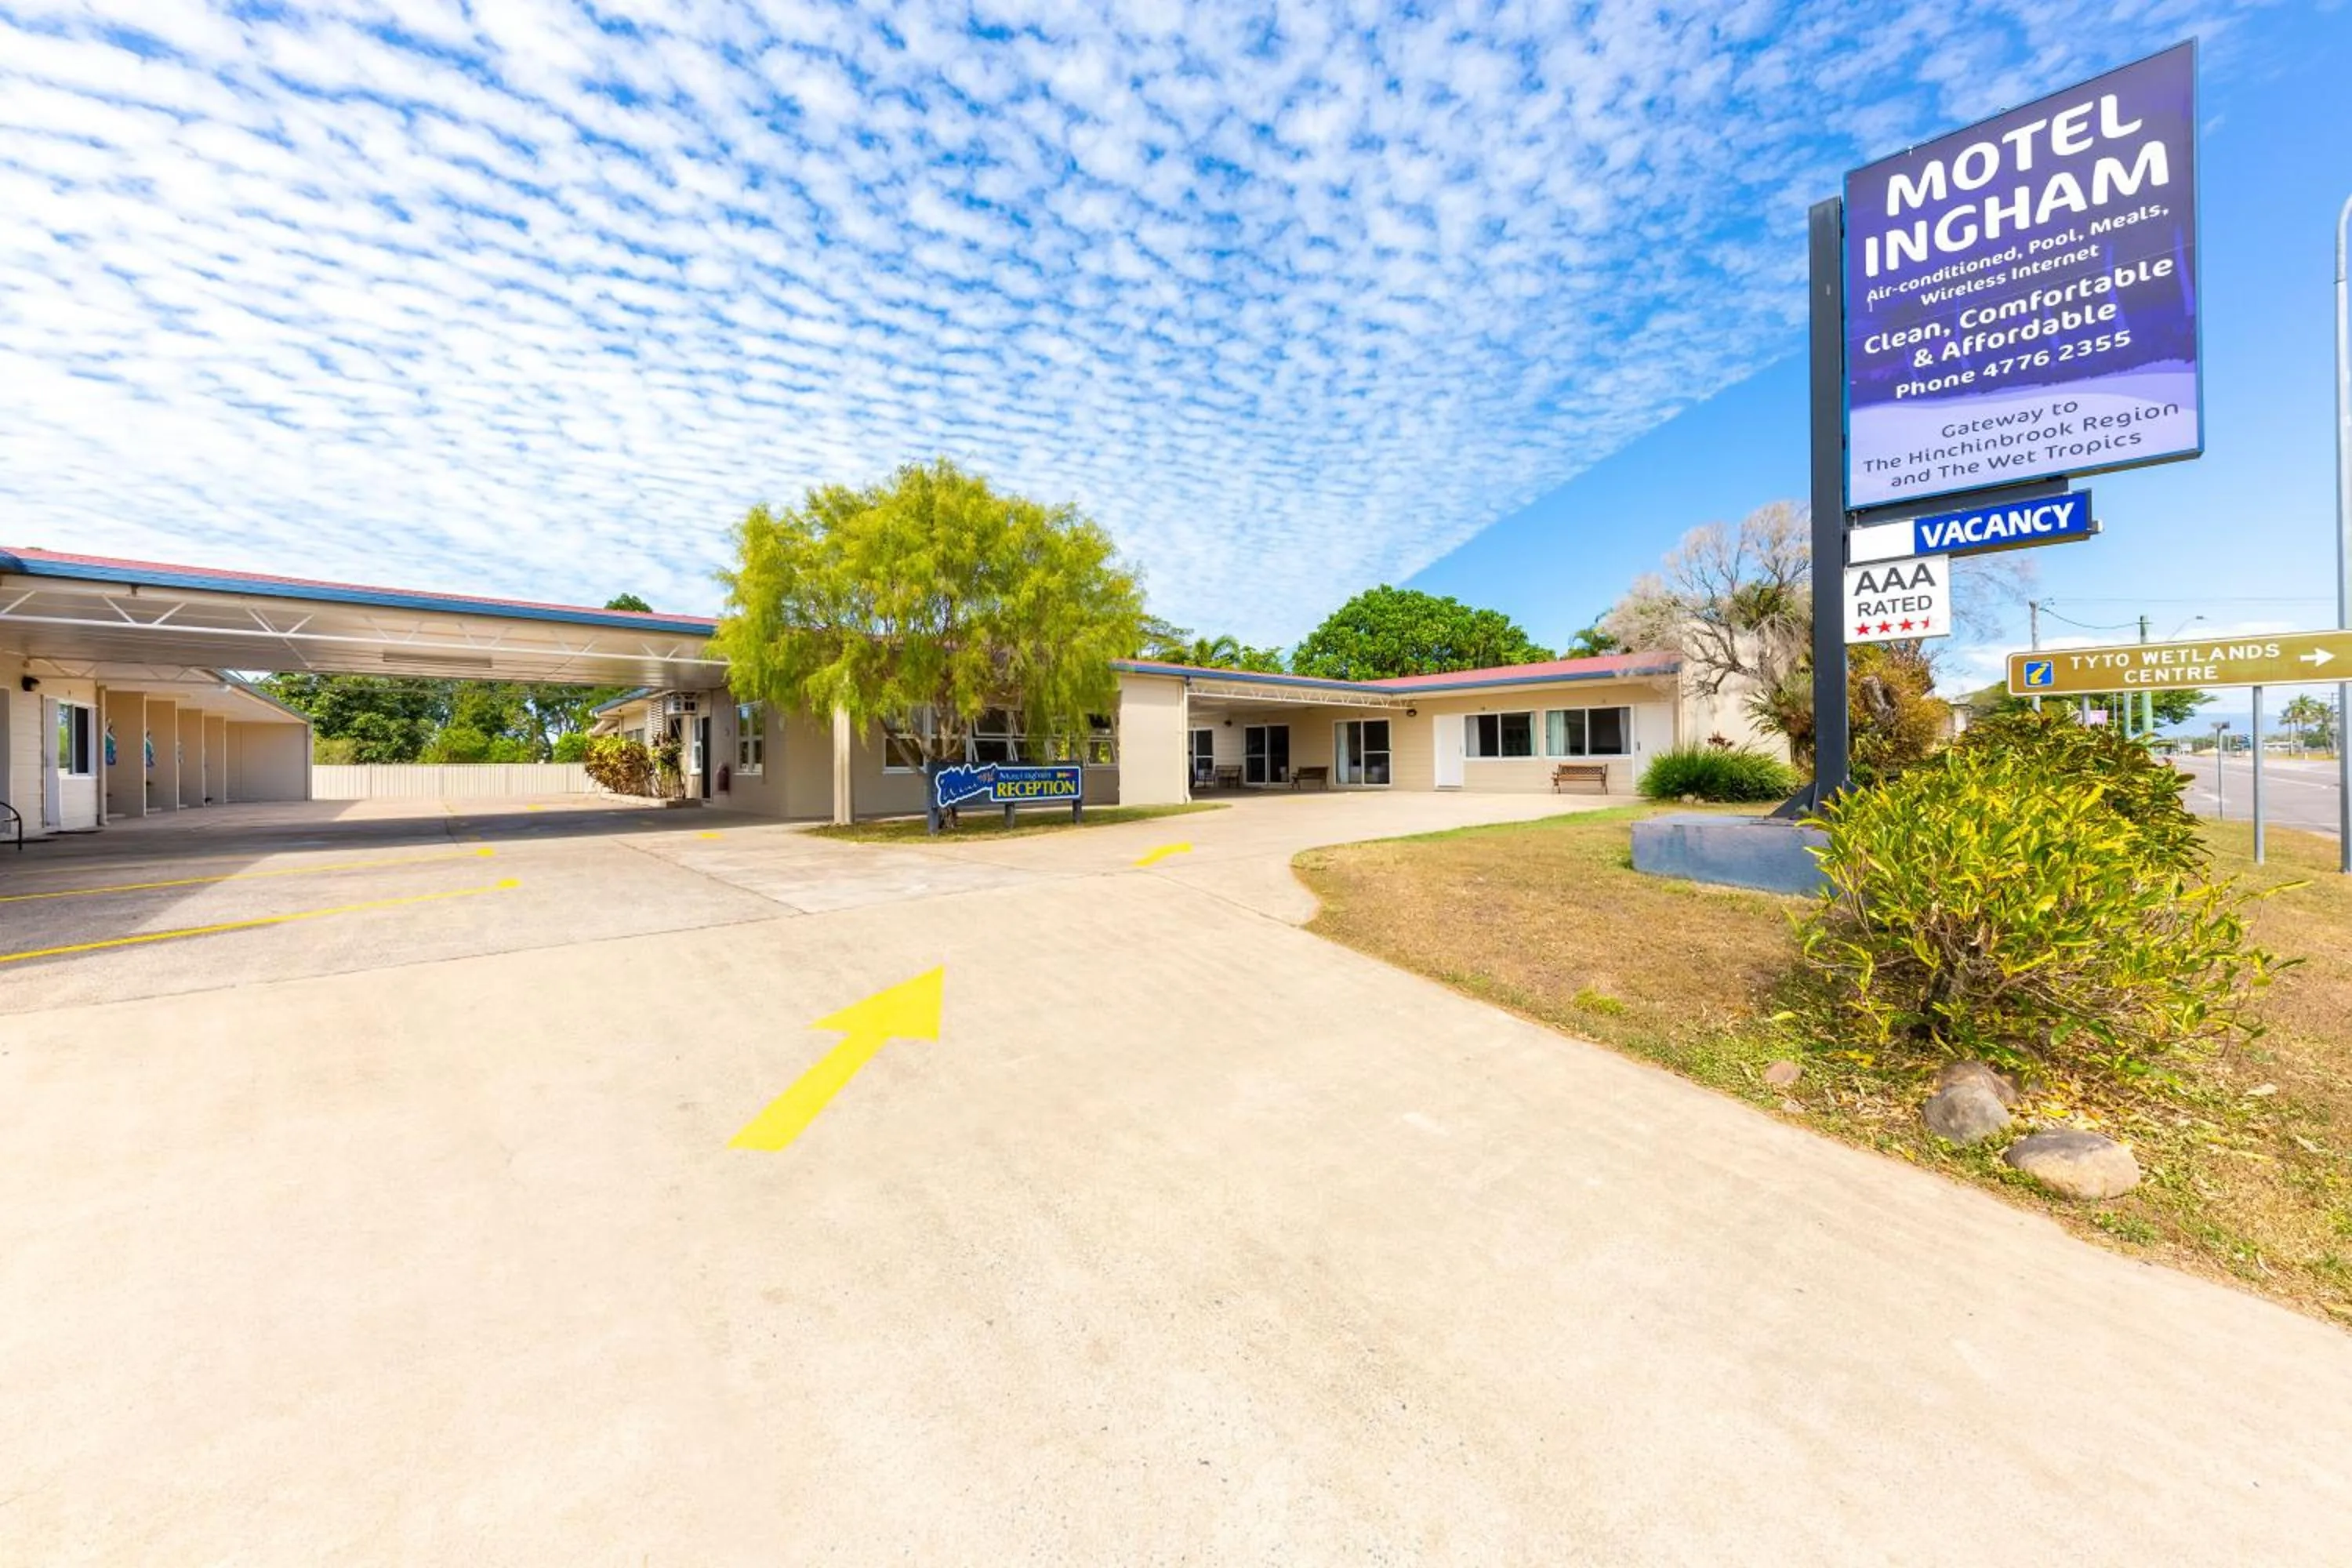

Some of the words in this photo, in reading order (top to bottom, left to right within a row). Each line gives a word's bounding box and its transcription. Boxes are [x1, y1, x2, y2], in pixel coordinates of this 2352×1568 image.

[1886, 93, 2143, 216] MOTEL
[1865, 140, 2170, 277] INGHAM
[1867, 245, 2024, 303] Air-conditioned,
[2029, 227, 2085, 256] Pool,
[2090, 205, 2170, 235] Meals,
[1920, 273, 2007, 307] Wireless
[2011, 244, 2100, 280] Internet
[1864, 319, 1951, 354] Clean,
[1959, 258, 2175, 330] Comfortable
[1913, 348, 1934, 368] &
[1942, 300, 2118, 362] Affordable
[1895, 368, 1976, 399] Phone
[1983, 350, 2051, 378] 4776
[2058, 329, 2132, 363] 2355
[1864, 456, 1902, 474] The
[1908, 422, 2074, 463] Hinchinbrook
[2082, 401, 2180, 431] Region
[1941, 407, 2044, 439] Gateway
[2053, 401, 2079, 416] to
[1891, 470, 1930, 488] and
[1938, 459, 1980, 480] The
[1987, 448, 2038, 470] Wet
[2045, 430, 2143, 459] Tropics
[1920, 502, 2074, 549] VACANCY
[1853, 562, 1936, 597] AAA
[1857, 594, 1933, 618] RATED
[2070, 653, 2130, 670] TYTO
[2141, 643, 2281, 666] WETLANDS
[2123, 665, 2220, 684] CENTRE
[996, 780, 1076, 797] RECEPTION
